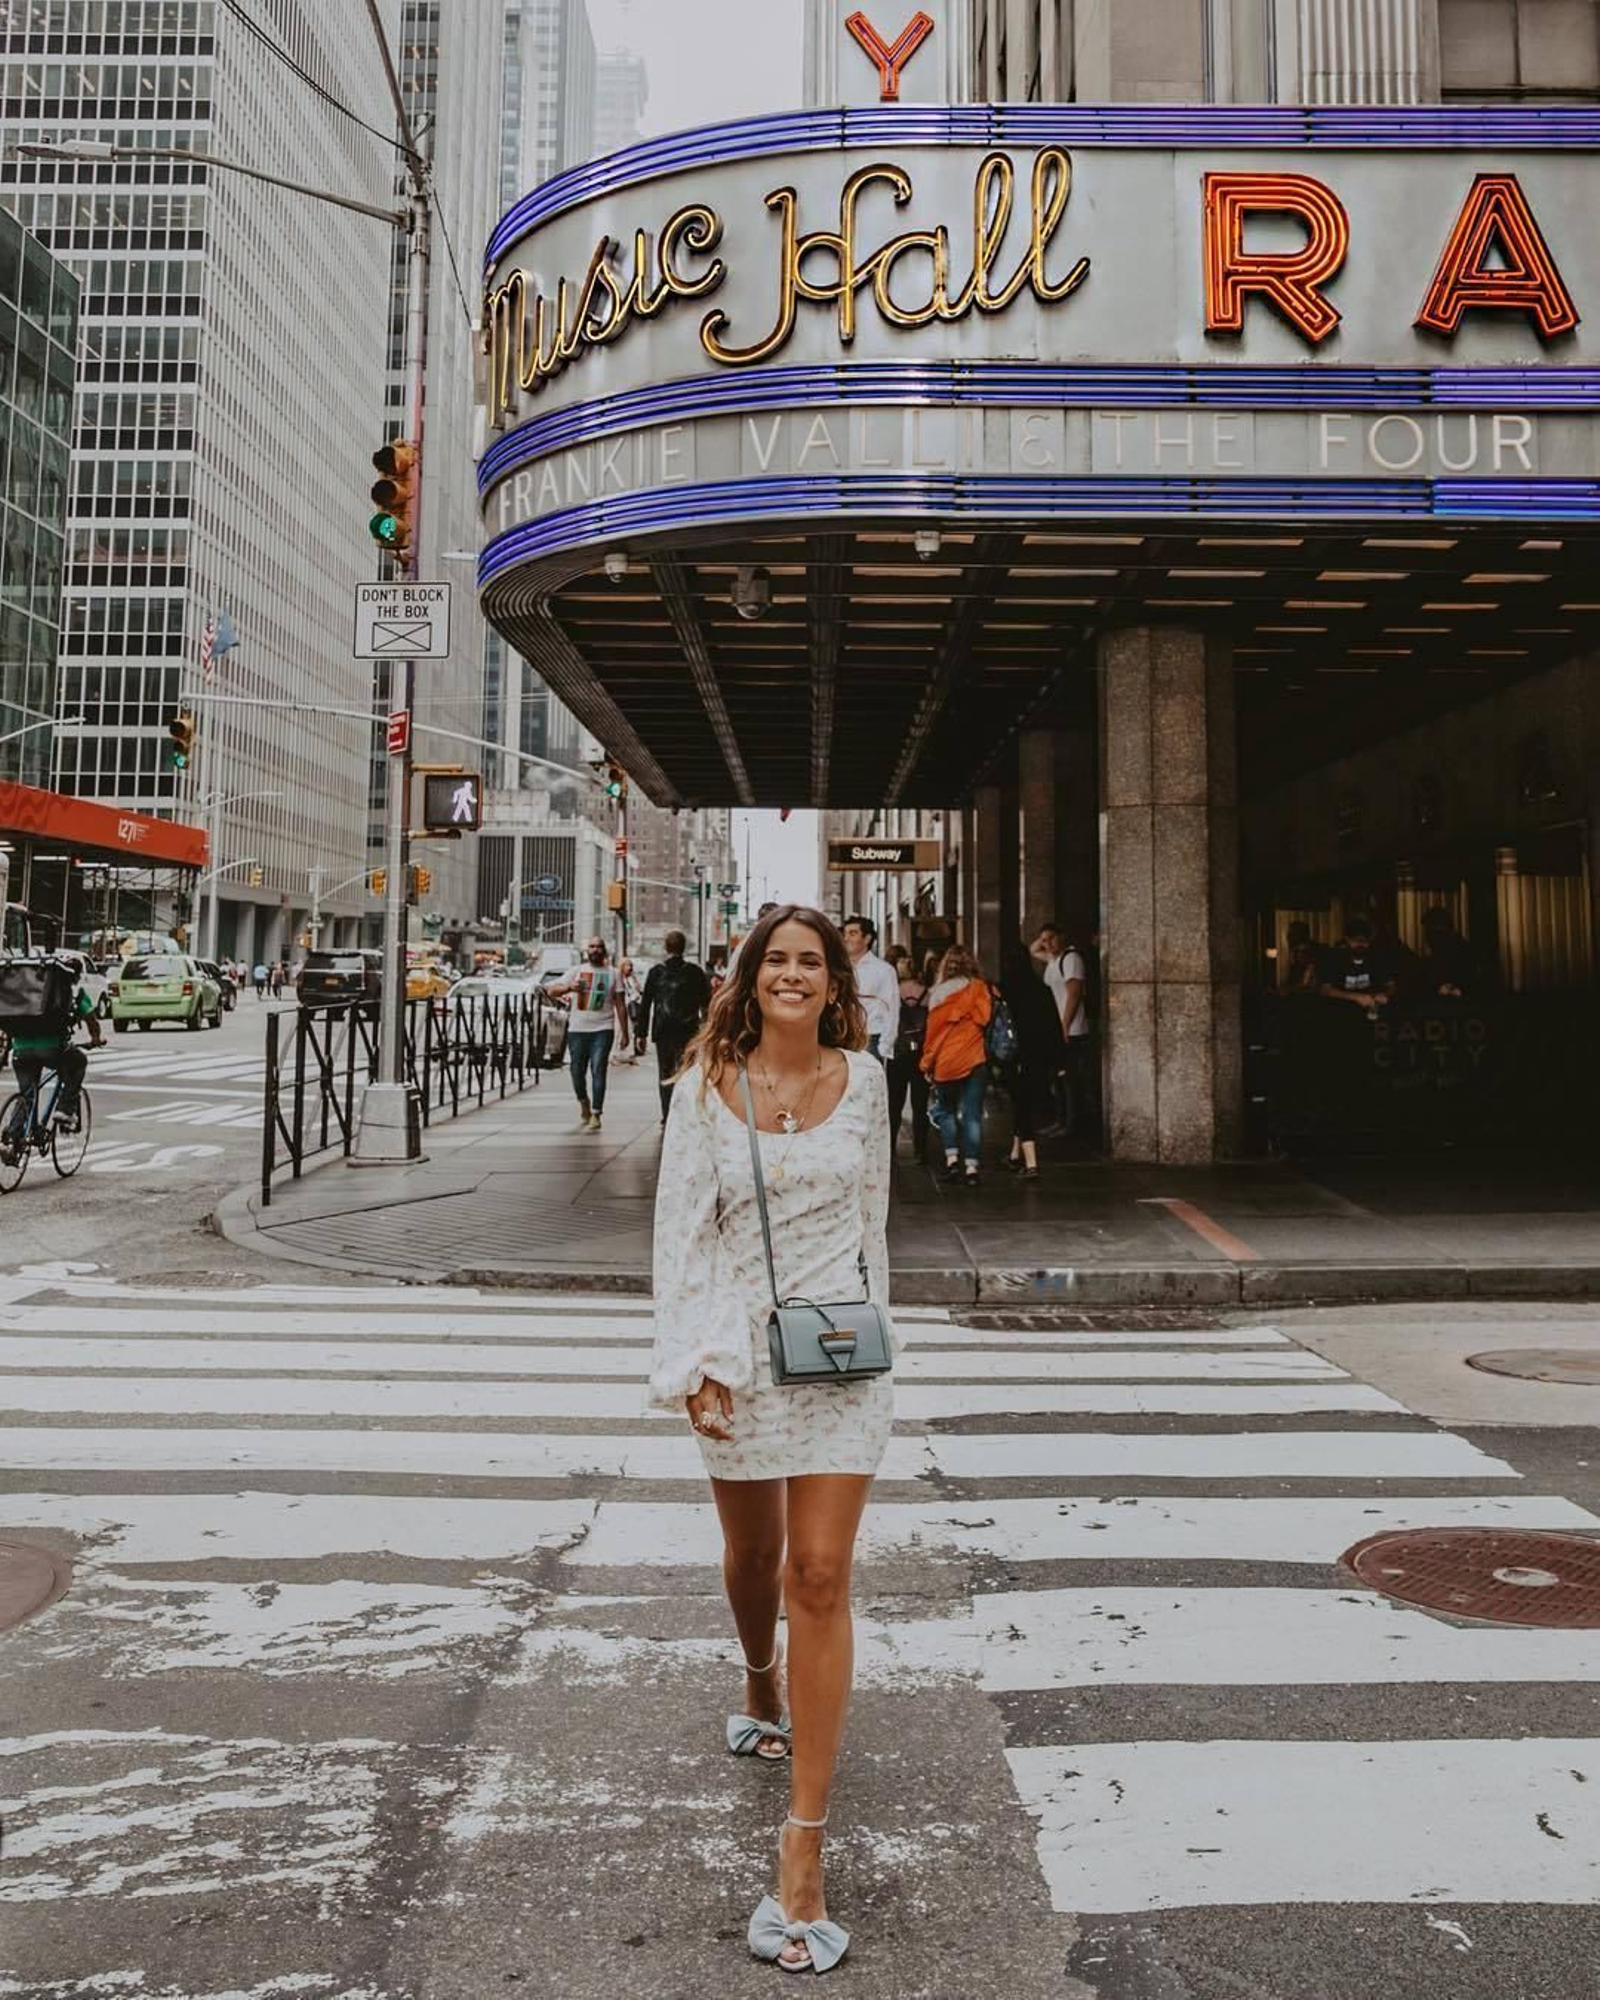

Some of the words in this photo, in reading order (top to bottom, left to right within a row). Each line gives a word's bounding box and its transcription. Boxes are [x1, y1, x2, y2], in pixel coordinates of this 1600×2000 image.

[845, 11, 934, 101] Y
[483, 203, 728, 430] Music
[699, 145, 1091, 366] Hall
[498, 425, 688, 532] FRANKIE
[748, 410, 973, 472] VALLI
[1018, 413, 1057, 468] &
[1100, 412, 1247, 470] THE
[1318, 412, 1534, 472] FOUR
[362, 589, 398, 602] DON'T
[403, 589, 444, 602] BLOCK
[377, 605, 400, 618] THE
[404, 605, 429, 618] BOX
[852, 847, 902, 862] Subway
[1373, 1018, 1487, 1043] RADIO
[1374, 1045, 1487, 1067] CITY
